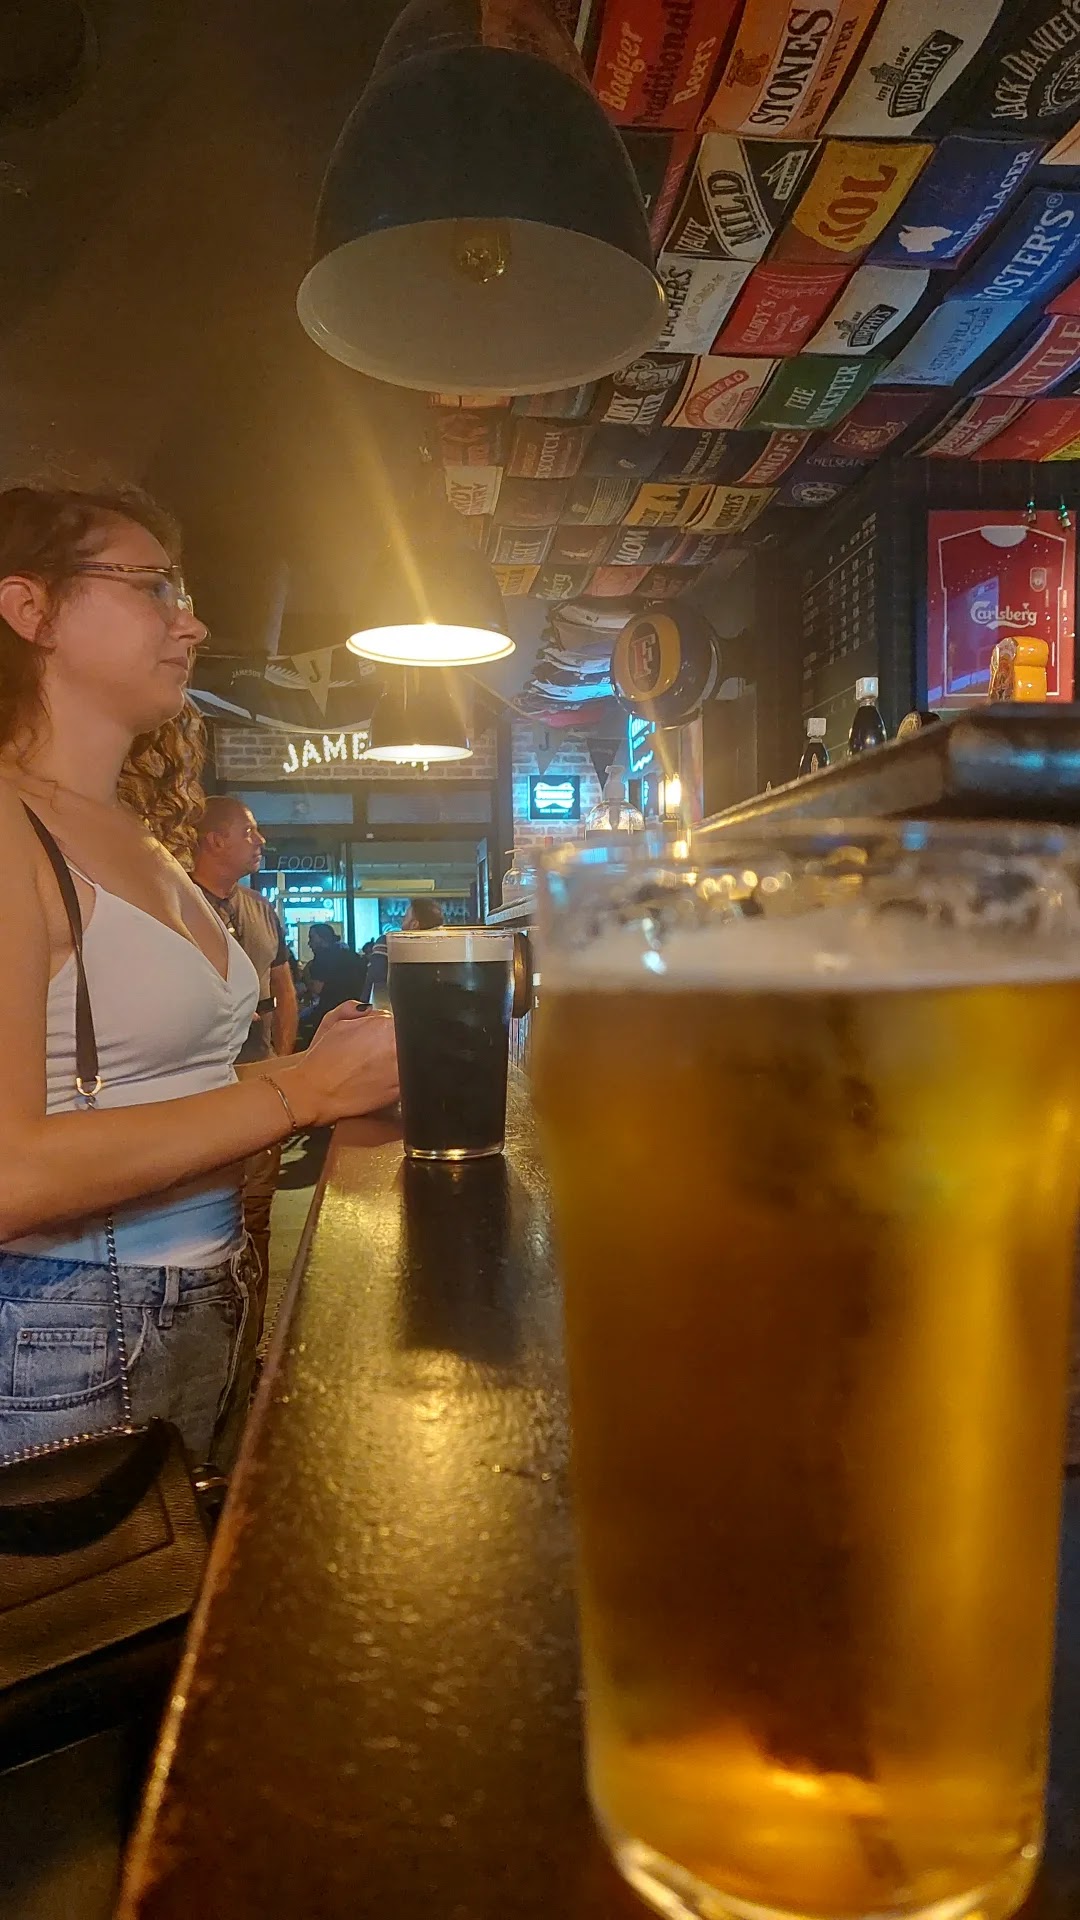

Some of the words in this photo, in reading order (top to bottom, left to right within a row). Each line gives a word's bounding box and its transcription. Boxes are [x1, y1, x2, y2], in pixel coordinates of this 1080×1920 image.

[599, 21, 646, 111] Badger
[672, 36, 717, 105] Beers
[748, 8, 834, 126] STONES
[819, 15, 860, 83] BITTER
[990, 75, 1033, 120] JACK
[984, 146, 1037, 212] LAGER
[707, 169, 767, 248] MILD
[817, 163, 899, 245] SOL
[673, 216, 715, 254] VAUX
[947, 306, 981, 344] VILLA
[785, 386, 816, 412] THE
[969, 600, 1038, 628] Carlsberg
[231, 668, 262, 680] JAMESON
[308, 659, 321, 684] J
[633, 633, 657, 680] F
[276, 855, 326, 870] FOOD
